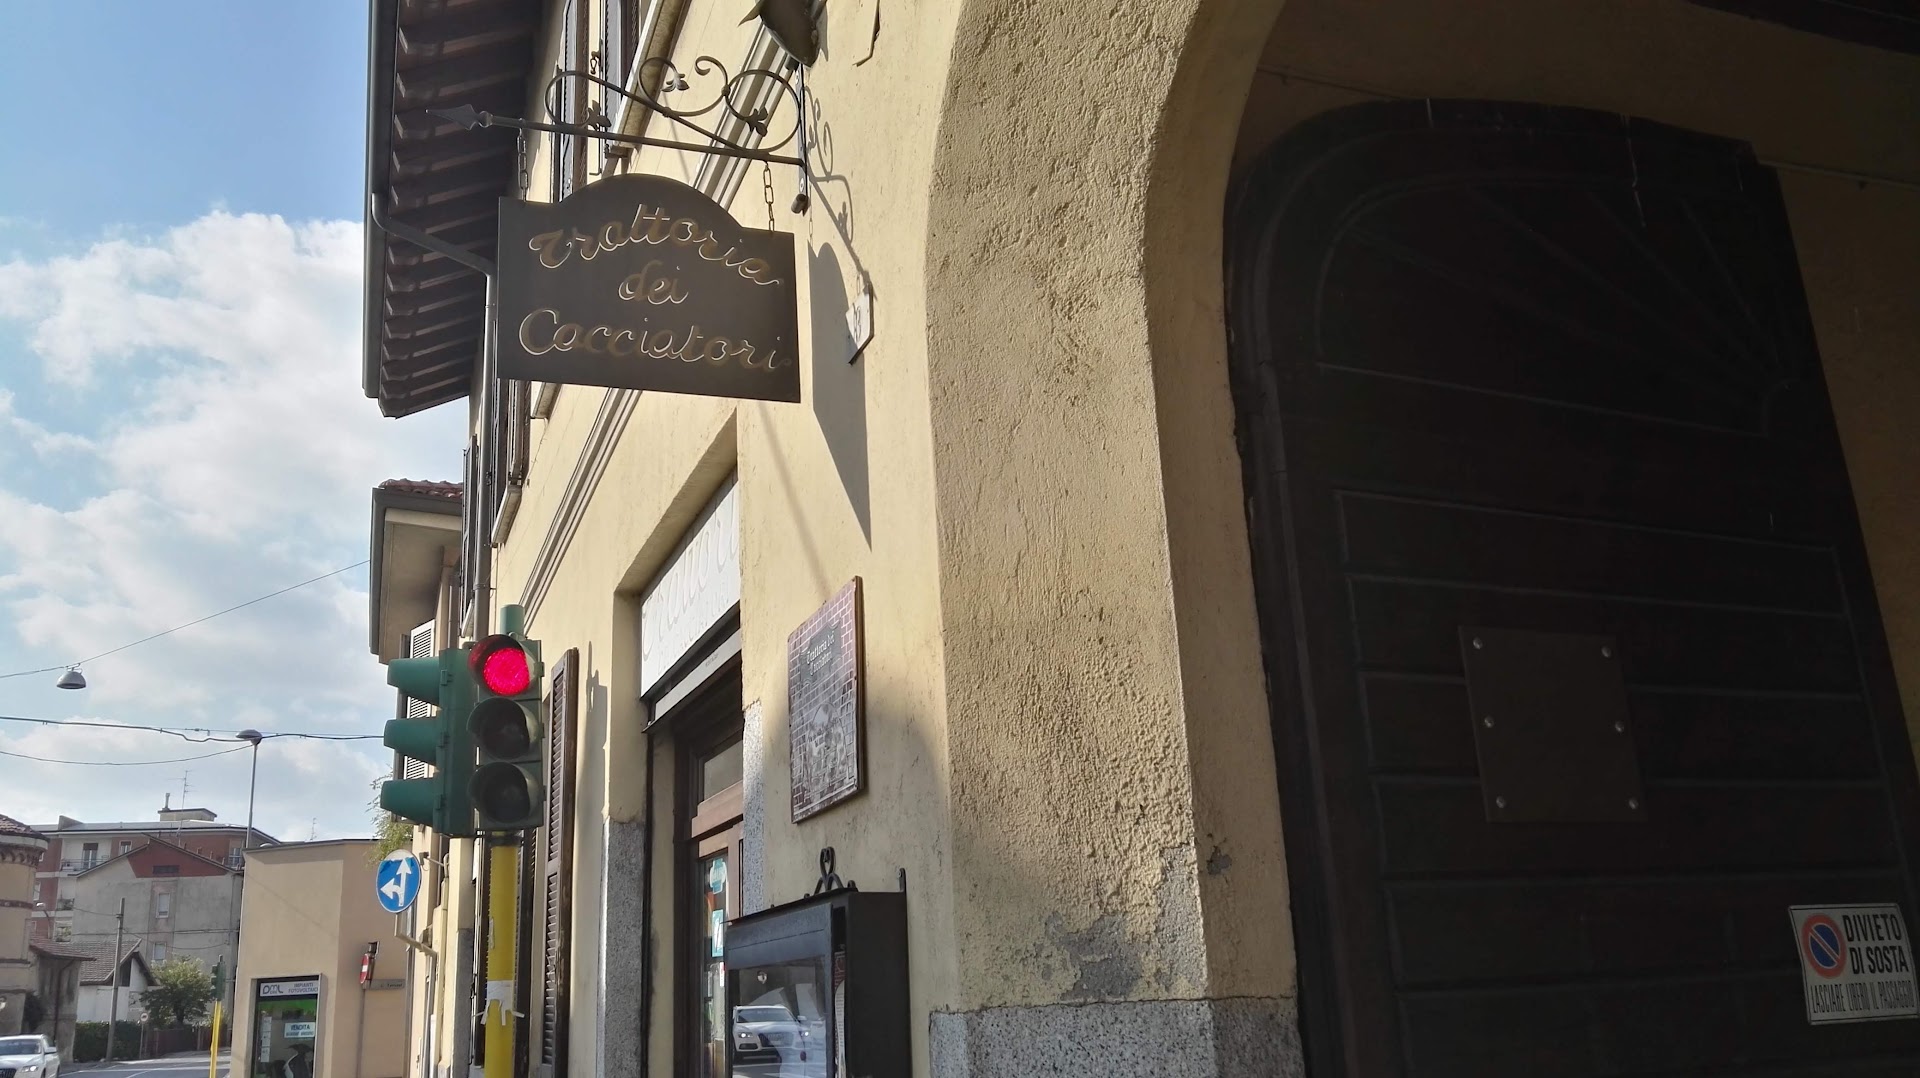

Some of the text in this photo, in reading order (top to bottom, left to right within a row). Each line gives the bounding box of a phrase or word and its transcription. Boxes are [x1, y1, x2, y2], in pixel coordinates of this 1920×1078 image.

[529, 204, 784, 286] Trattoria
[618, 260, 689, 305] dei
[518, 308, 792, 373] Cacciatori
[1842, 914, 1902, 941] DIVIETO
[1849, 945, 1909, 974] DI SOSTA
[1811, 983, 1846, 1013] LASCIARE
[1846, 982, 1870, 1011] LIBERO
[1870, 982, 1879, 1010] IL
